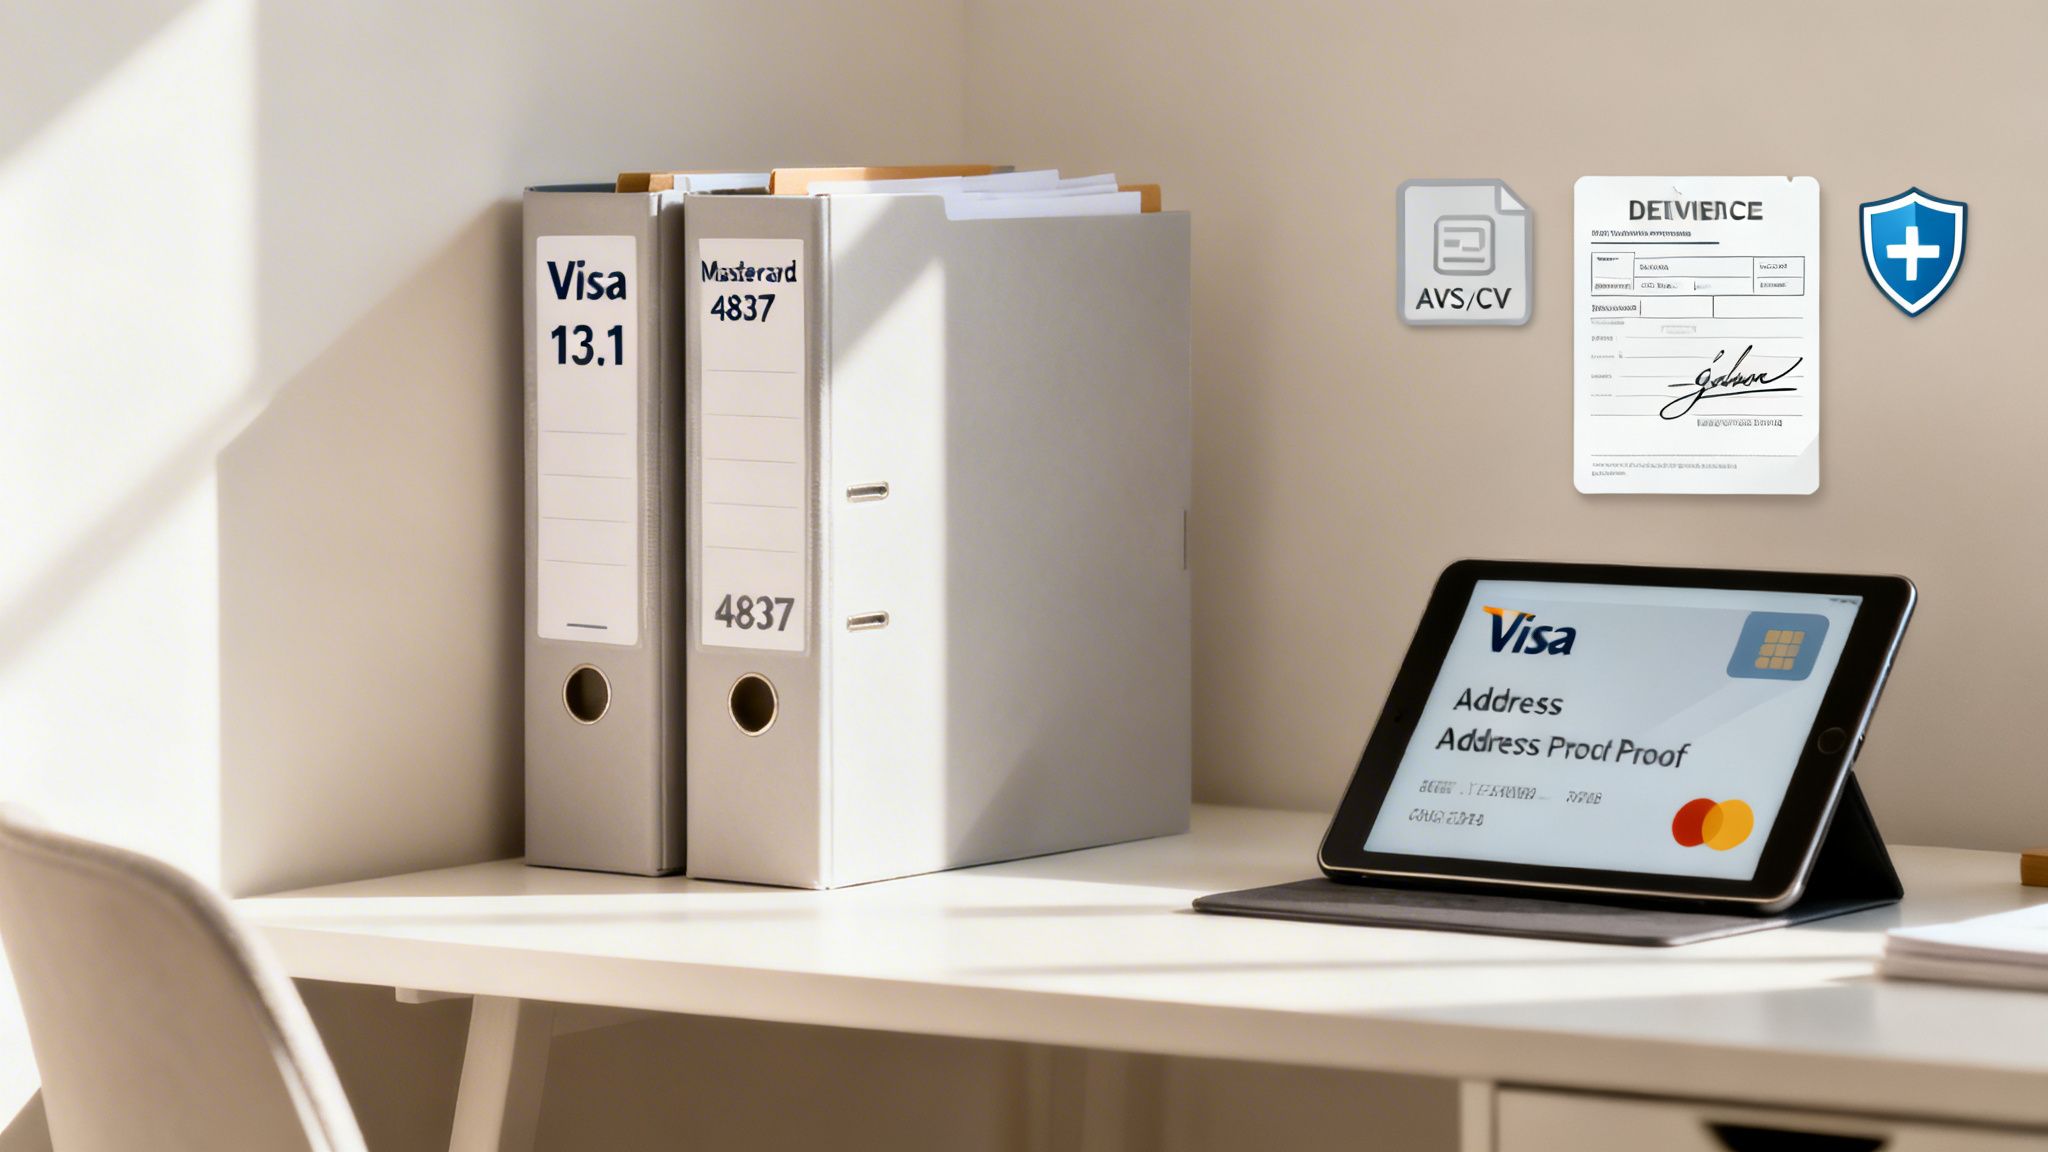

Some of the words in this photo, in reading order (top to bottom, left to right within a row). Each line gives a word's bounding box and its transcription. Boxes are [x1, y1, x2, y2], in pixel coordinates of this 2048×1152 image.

[546, 259, 628, 301] Visa
[1415, 287, 1513, 312] AVS/CV
[710, 293, 777, 323] 4837
[551, 324, 624, 367] 13.1
[714, 593, 796, 632] 4837
[1482, 605, 1578, 656] Visa
[1452, 686, 1564, 716] Address
[1435, 726, 1542, 756] Address
[1615, 737, 1693, 769] Proof
